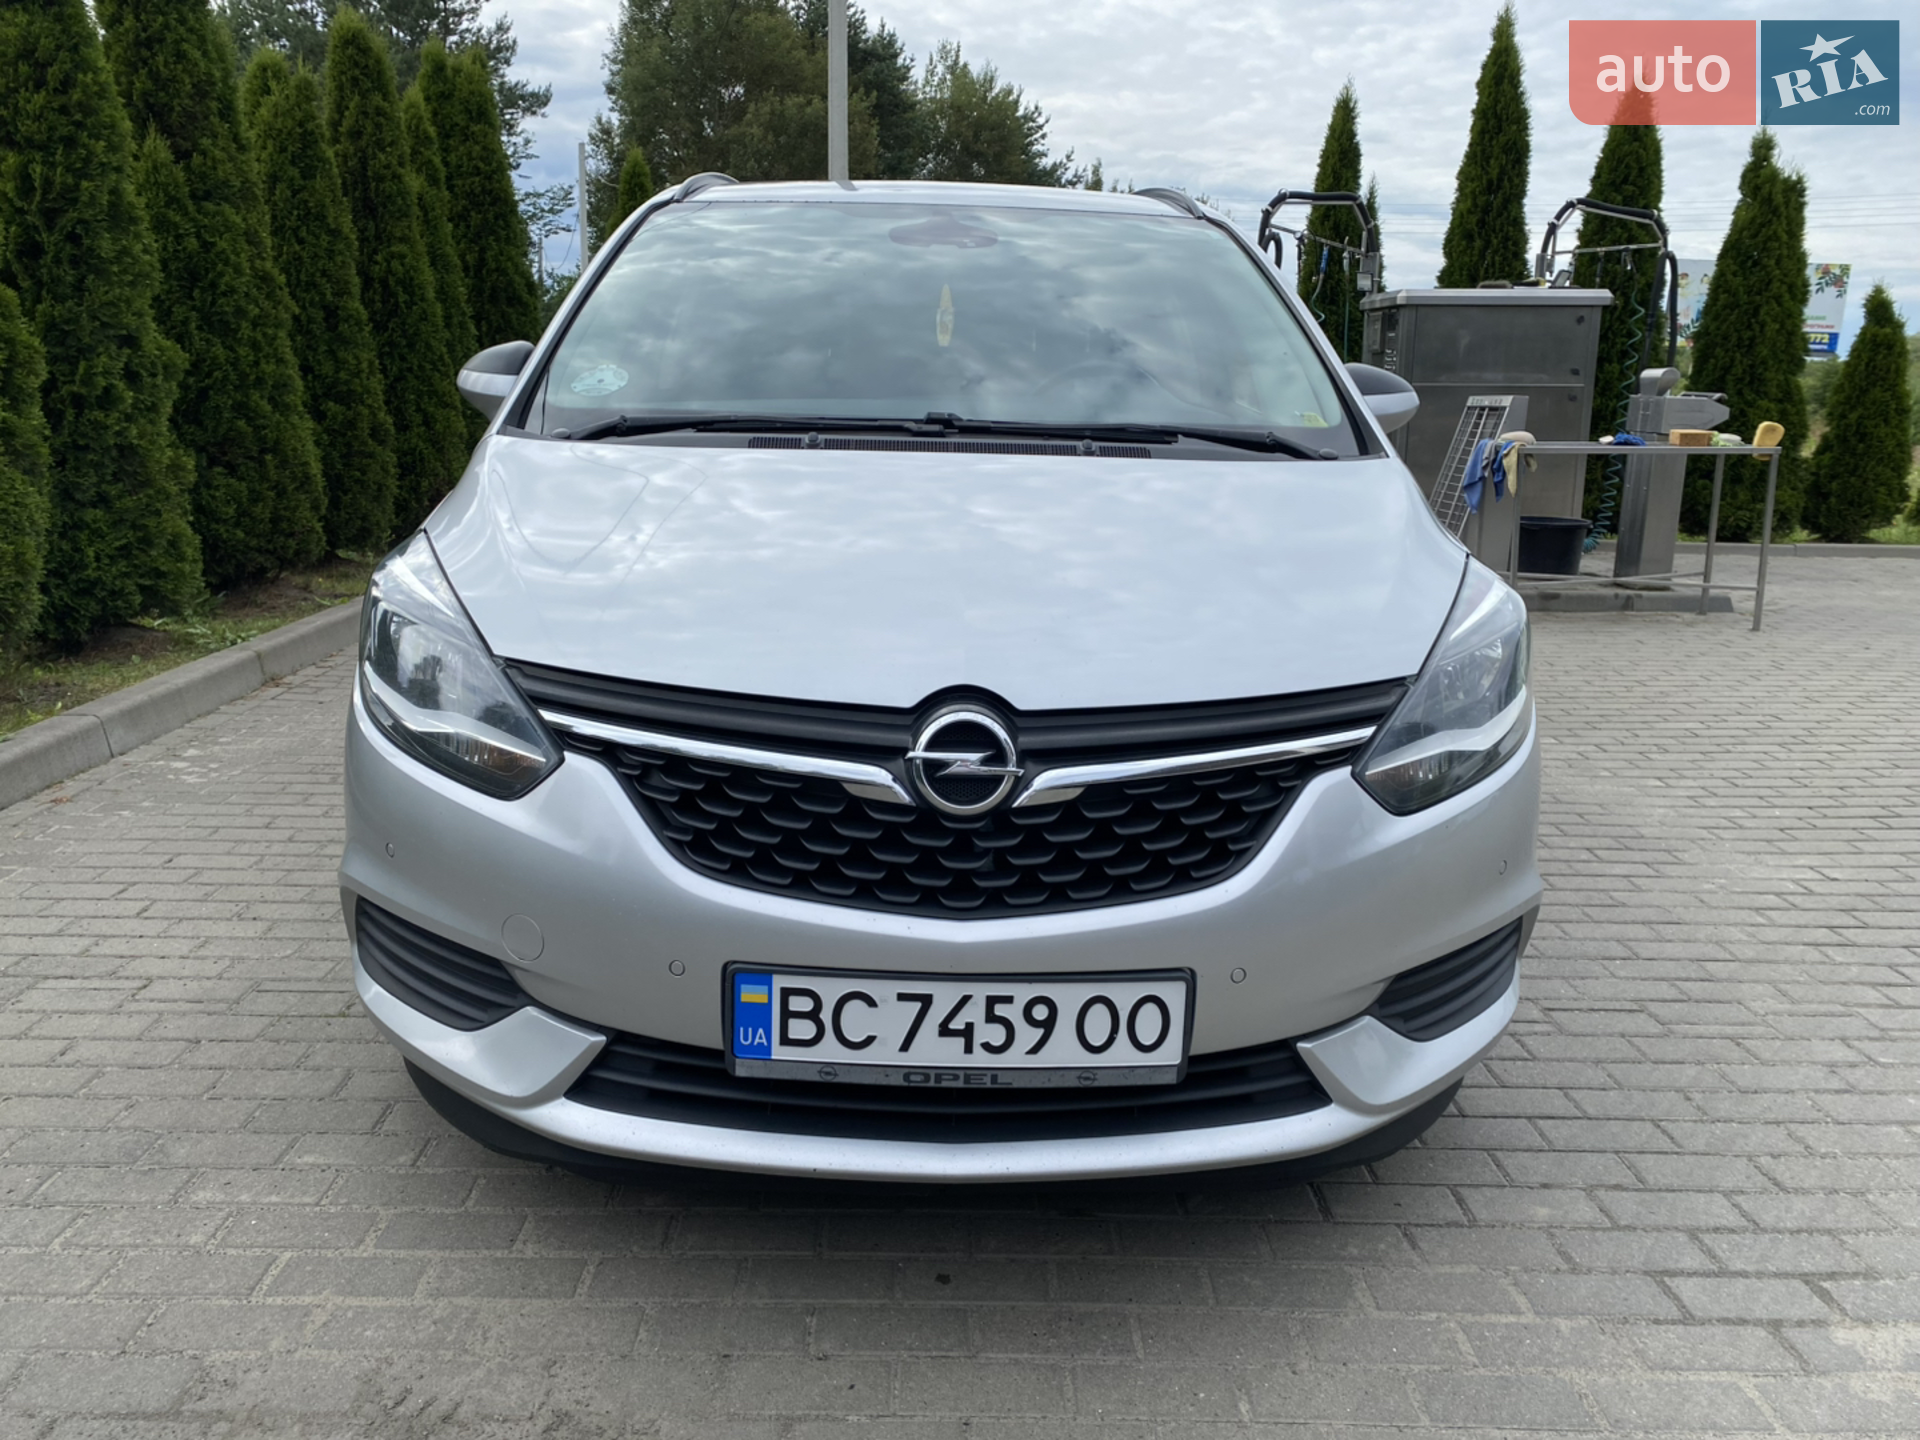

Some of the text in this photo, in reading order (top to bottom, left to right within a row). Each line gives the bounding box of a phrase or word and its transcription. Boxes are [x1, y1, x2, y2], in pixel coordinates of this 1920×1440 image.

[779, 986, 878, 1050] BC
[896, 993, 1058, 1055] 7459
[739, 1026, 768, 1046] UA
[902, 1071, 1013, 1086] OPEL
